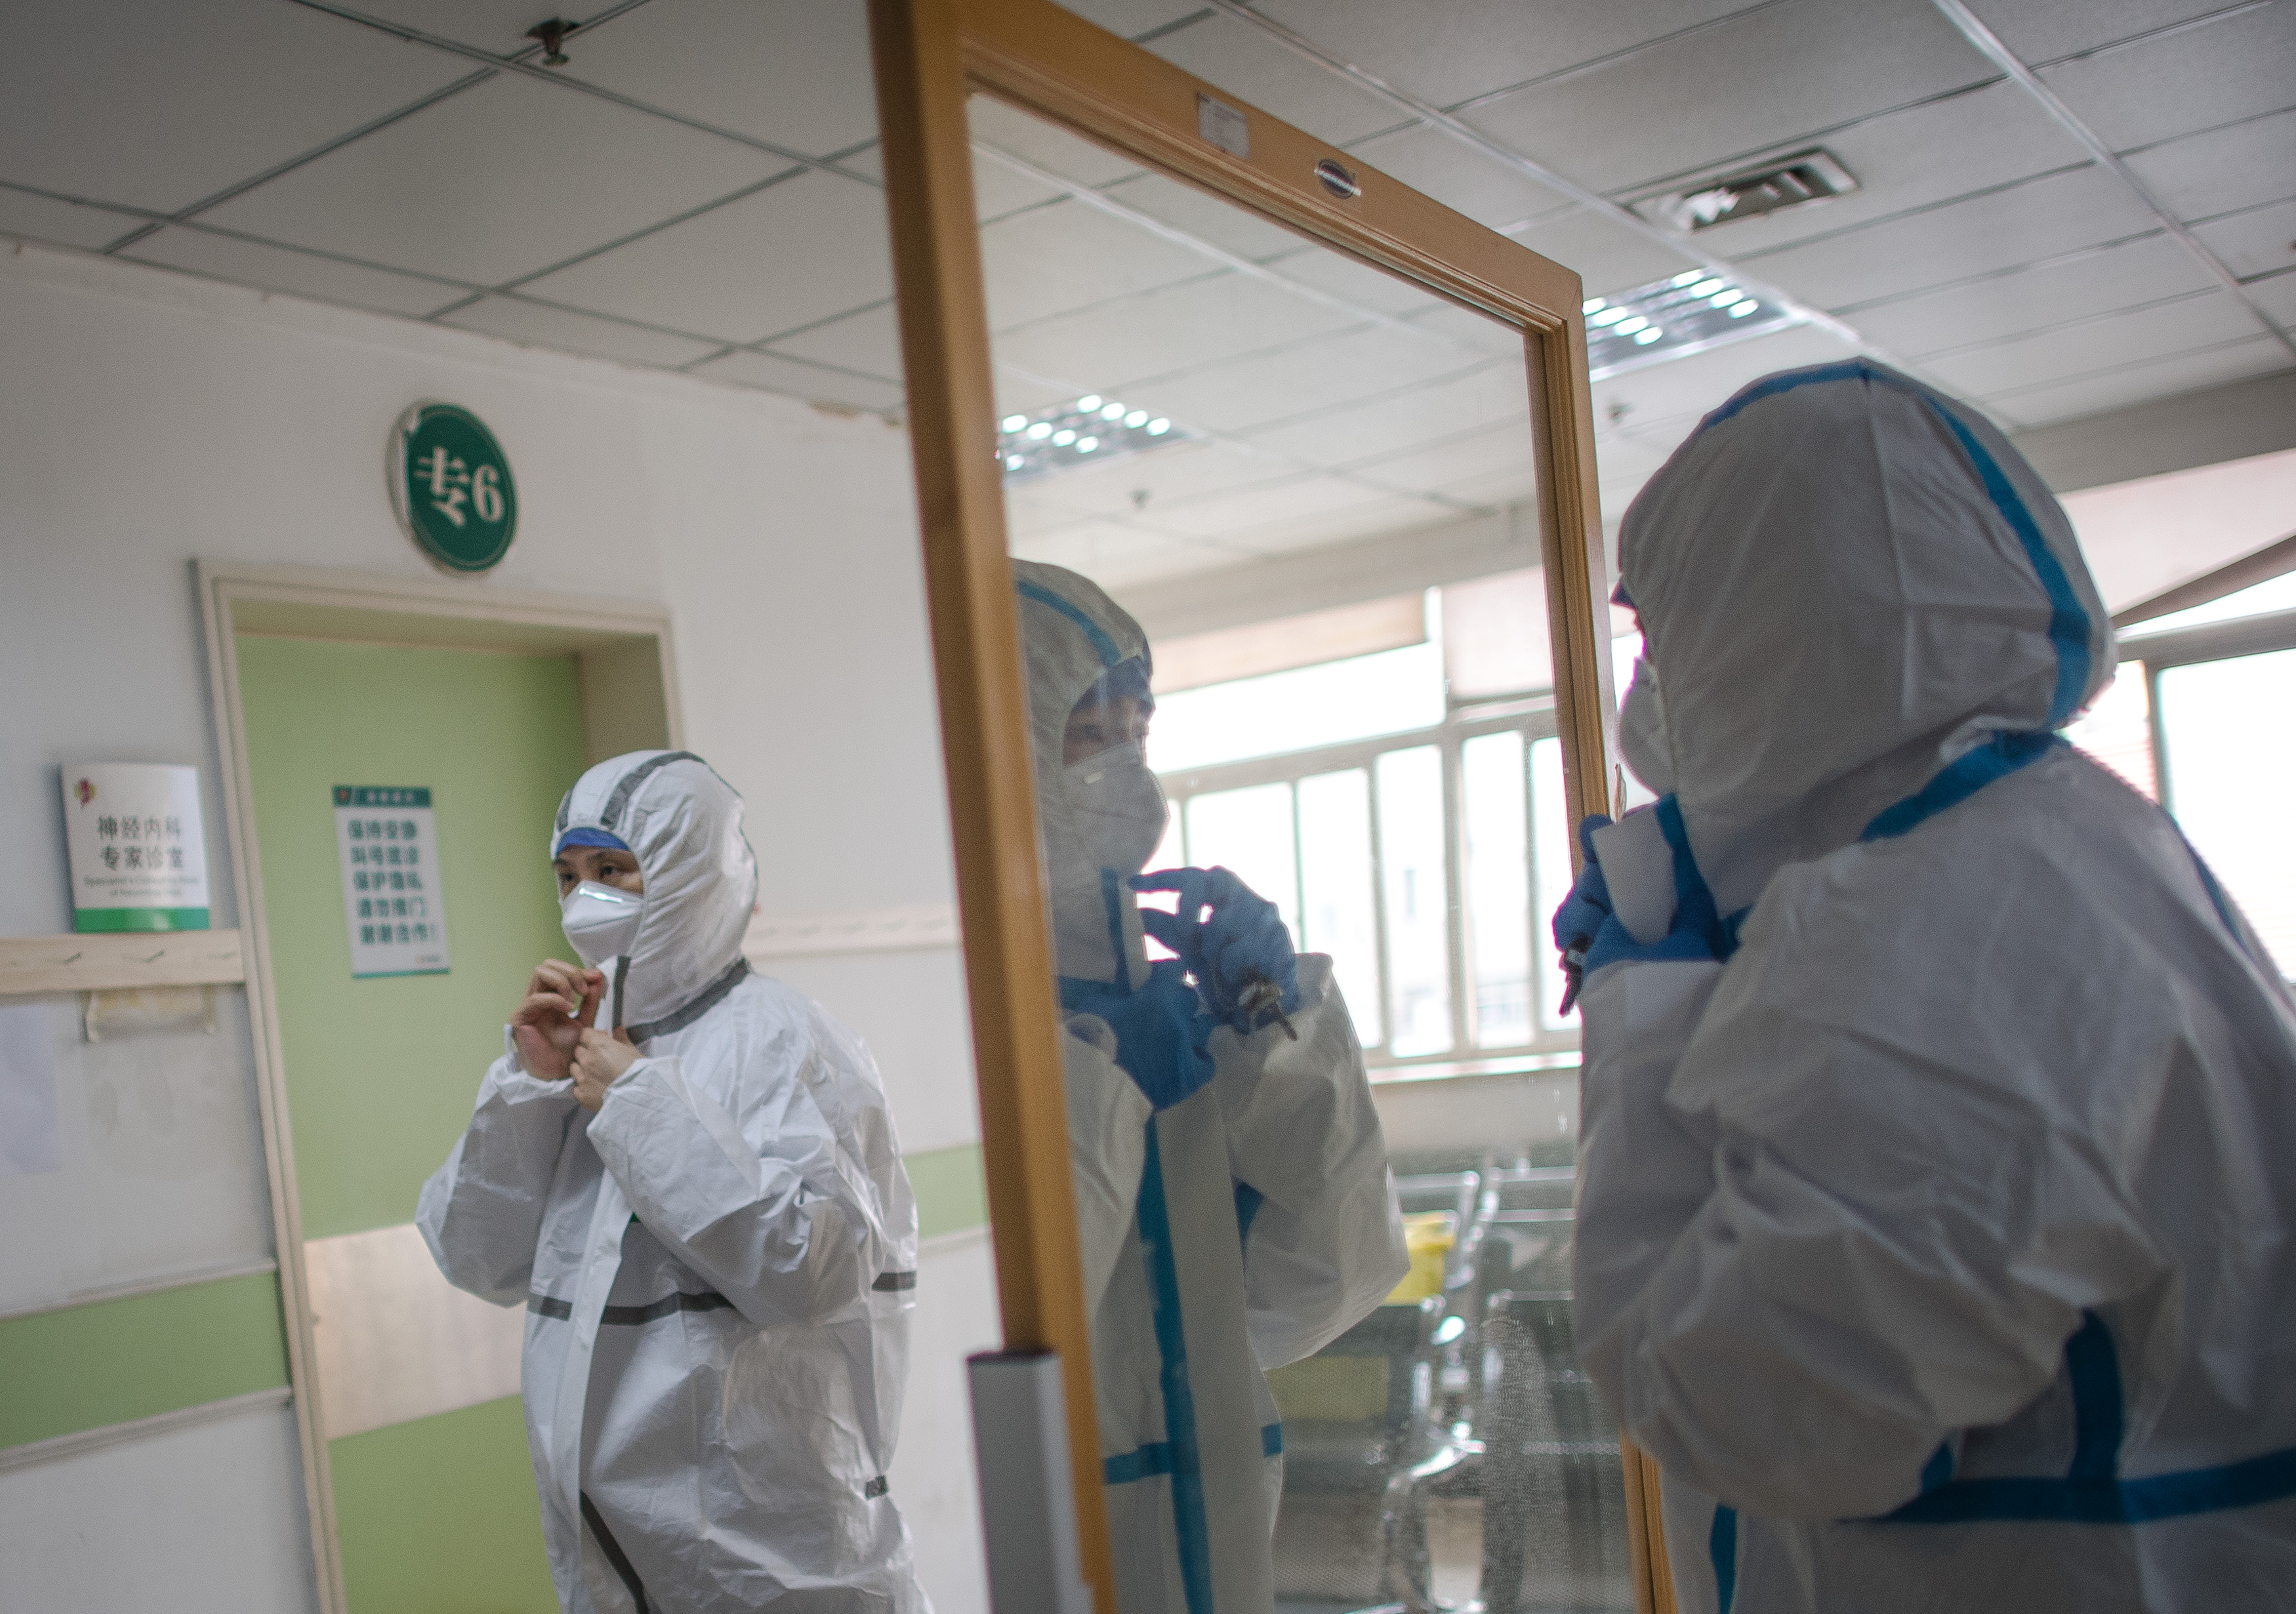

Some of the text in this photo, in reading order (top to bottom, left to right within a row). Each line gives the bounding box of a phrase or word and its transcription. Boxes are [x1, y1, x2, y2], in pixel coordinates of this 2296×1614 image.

[97, 816, 181, 841] 神经内科
[100, 844, 184, 871] 专家诊室
